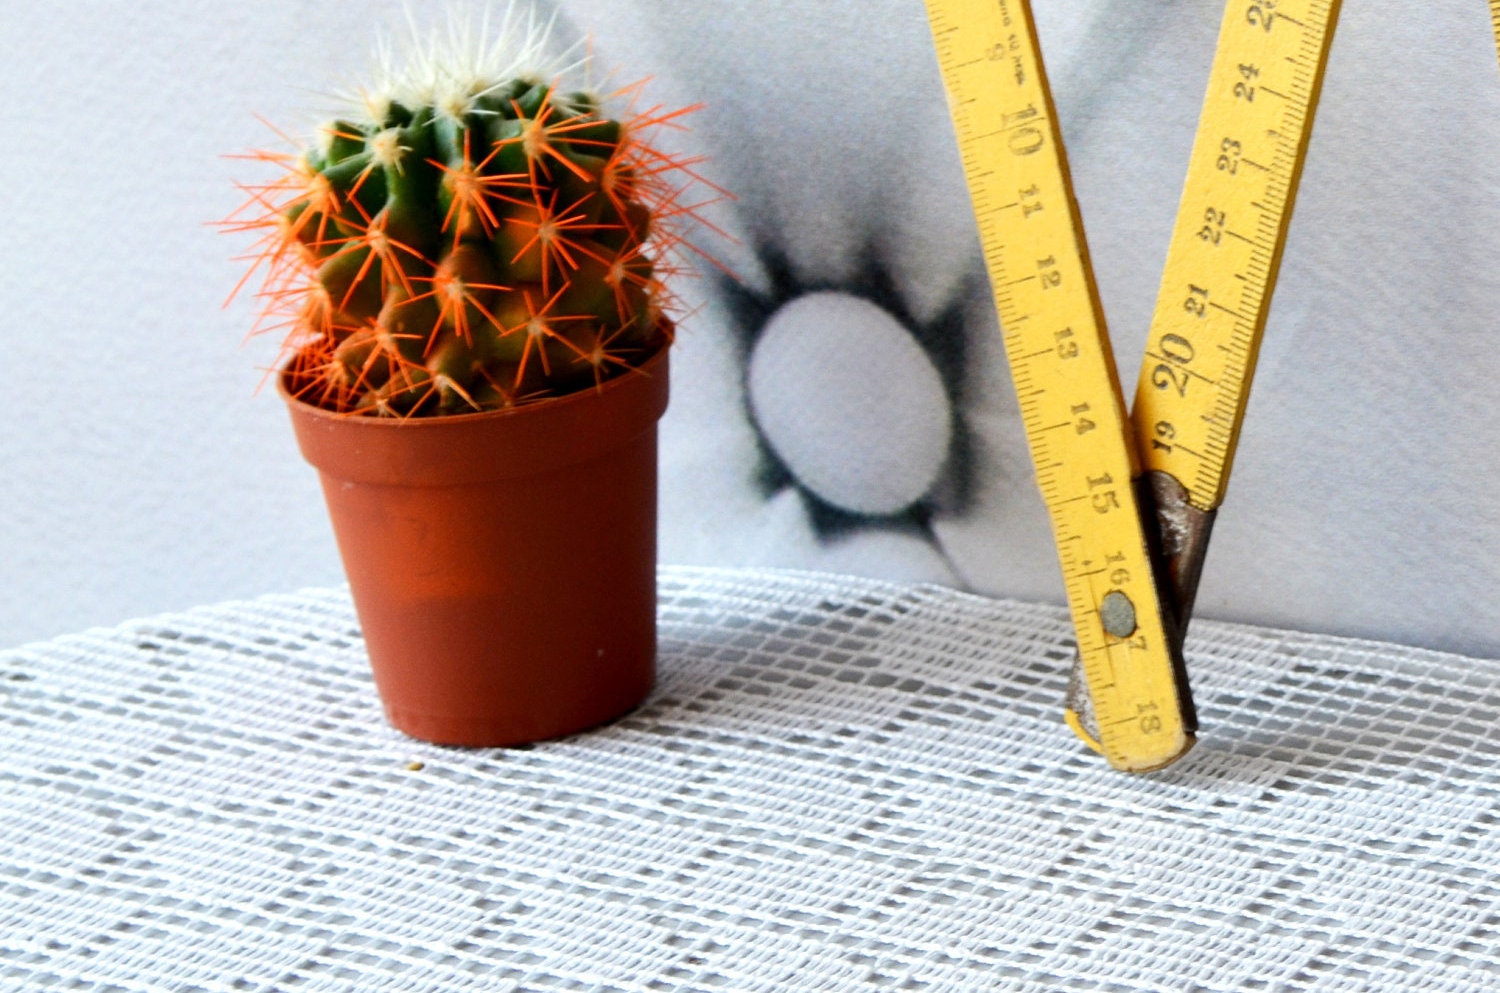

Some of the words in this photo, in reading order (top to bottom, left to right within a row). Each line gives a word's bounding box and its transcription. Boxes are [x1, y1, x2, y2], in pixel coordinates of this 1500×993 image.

[987, 41, 1006, 61] 9
[1231, 62, 1260, 103] 24
[1000, 101, 1045, 156] 10
[1215, 136, 1242, 175] 23
[1017, 182, 1044, 219] 11
[1195, 205, 1226, 245] 22
[1035, 253, 1062, 290] 12
[1182, 282, 1209, 318] 21
[1052, 325, 1079, 360] 13
[1149, 331, 1194, 398] 20
[1069, 400, 1097, 436] 14
[1148, 419, 1174, 453] 19
[1084, 471, 1121, 515] 15
[1103, 549, 1131, 586] 16
[1135, 699, 1163, 735] 18
